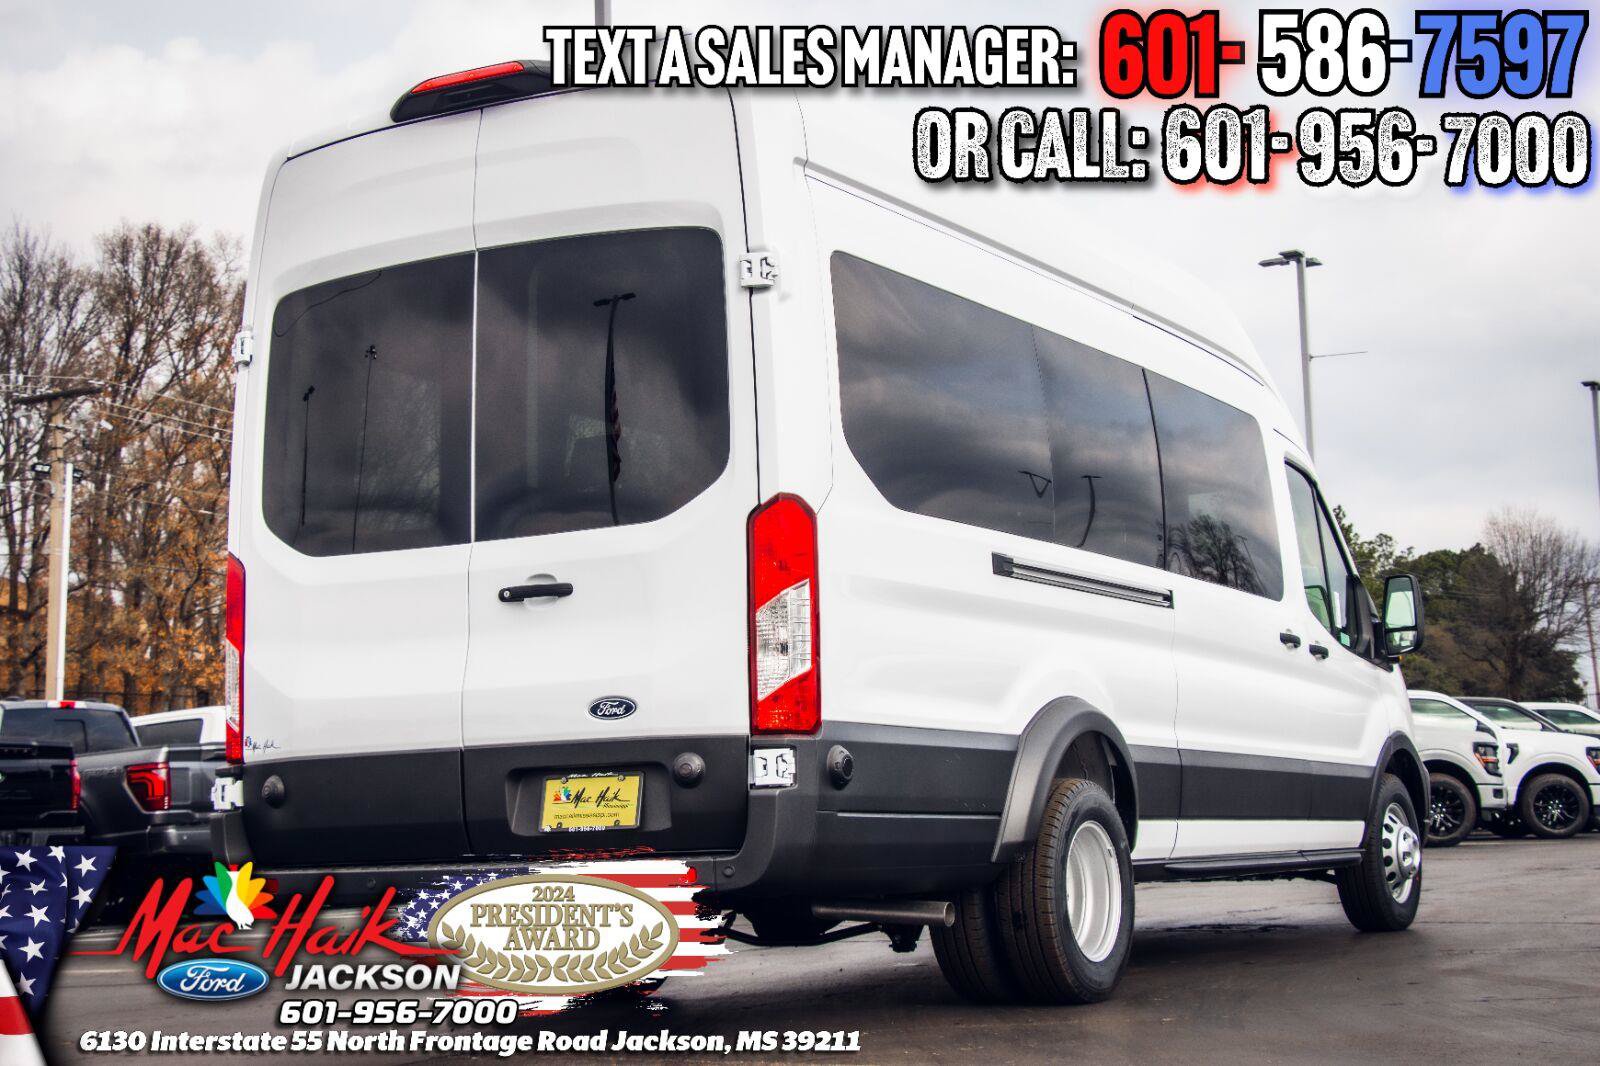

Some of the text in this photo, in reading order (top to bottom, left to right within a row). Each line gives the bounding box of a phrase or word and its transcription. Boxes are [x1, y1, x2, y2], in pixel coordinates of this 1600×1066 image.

[597, 701, 626, 715] Ford
[571, 786, 631, 809] Mac Haik
